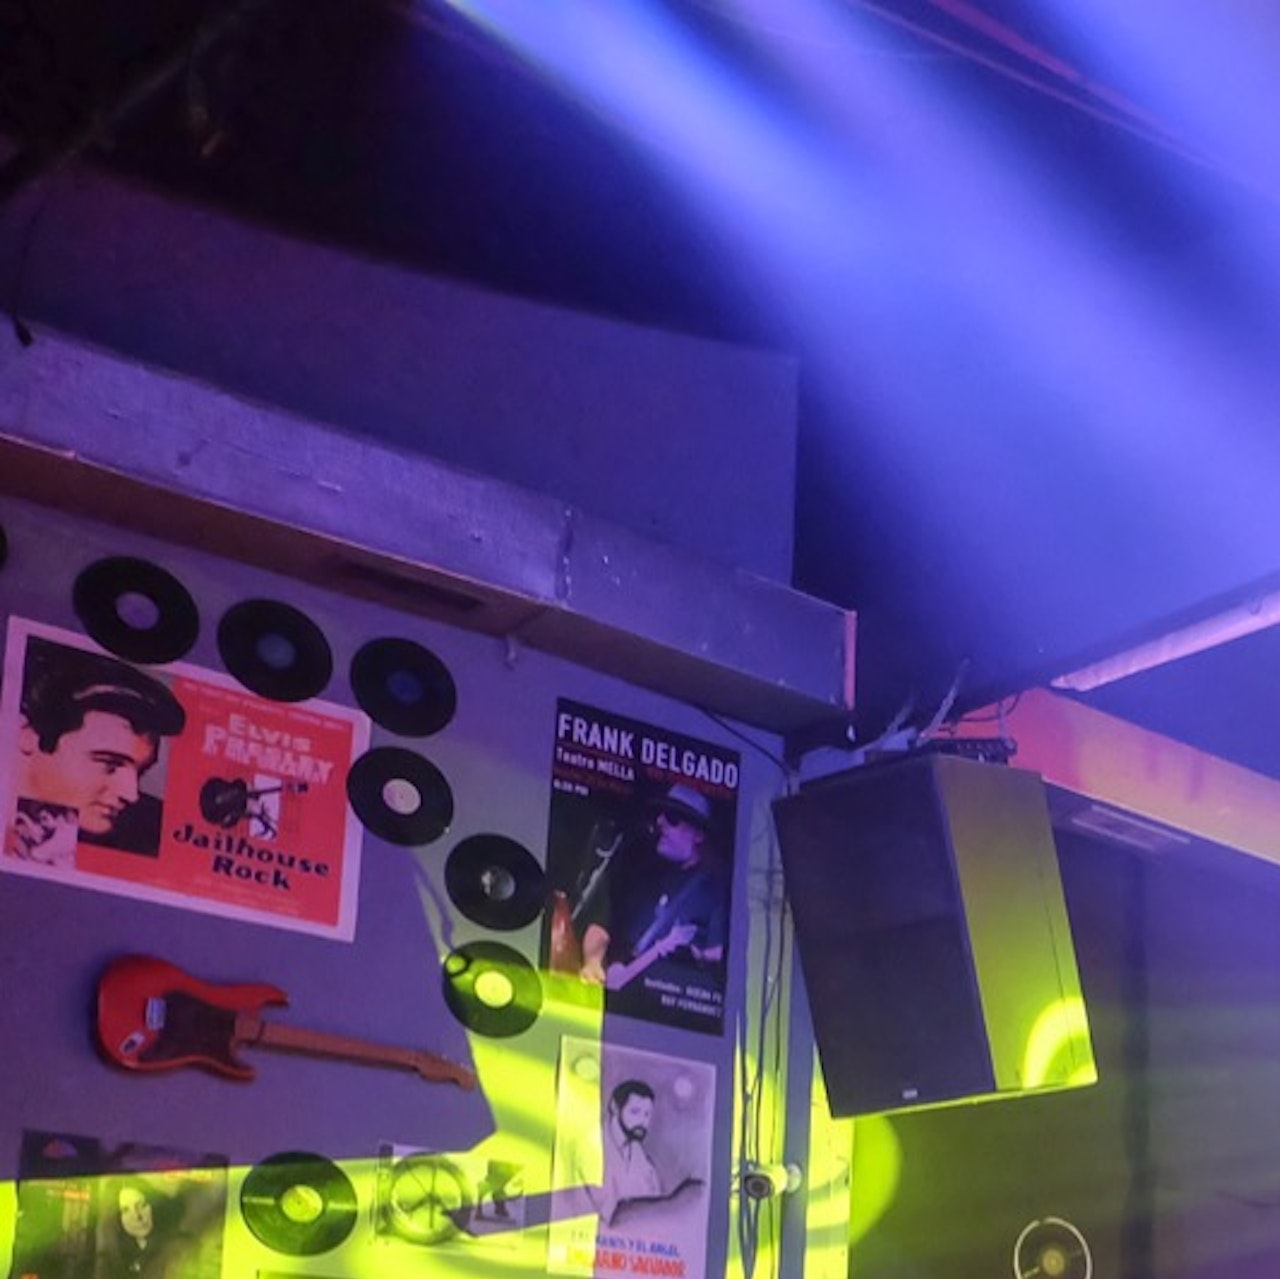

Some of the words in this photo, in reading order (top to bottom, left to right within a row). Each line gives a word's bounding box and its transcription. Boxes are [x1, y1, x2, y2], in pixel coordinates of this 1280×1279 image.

[229, 713, 311, 752] ELVIS
[558, 713, 635, 759] FRANK
[640, 737, 738, 789] DELGADO
[556, 747, 595, 768] Teatro
[596, 759, 635, 782] MELLA
[173, 824, 329, 877] Jailhouse
[212, 854, 290, 890] Rock
